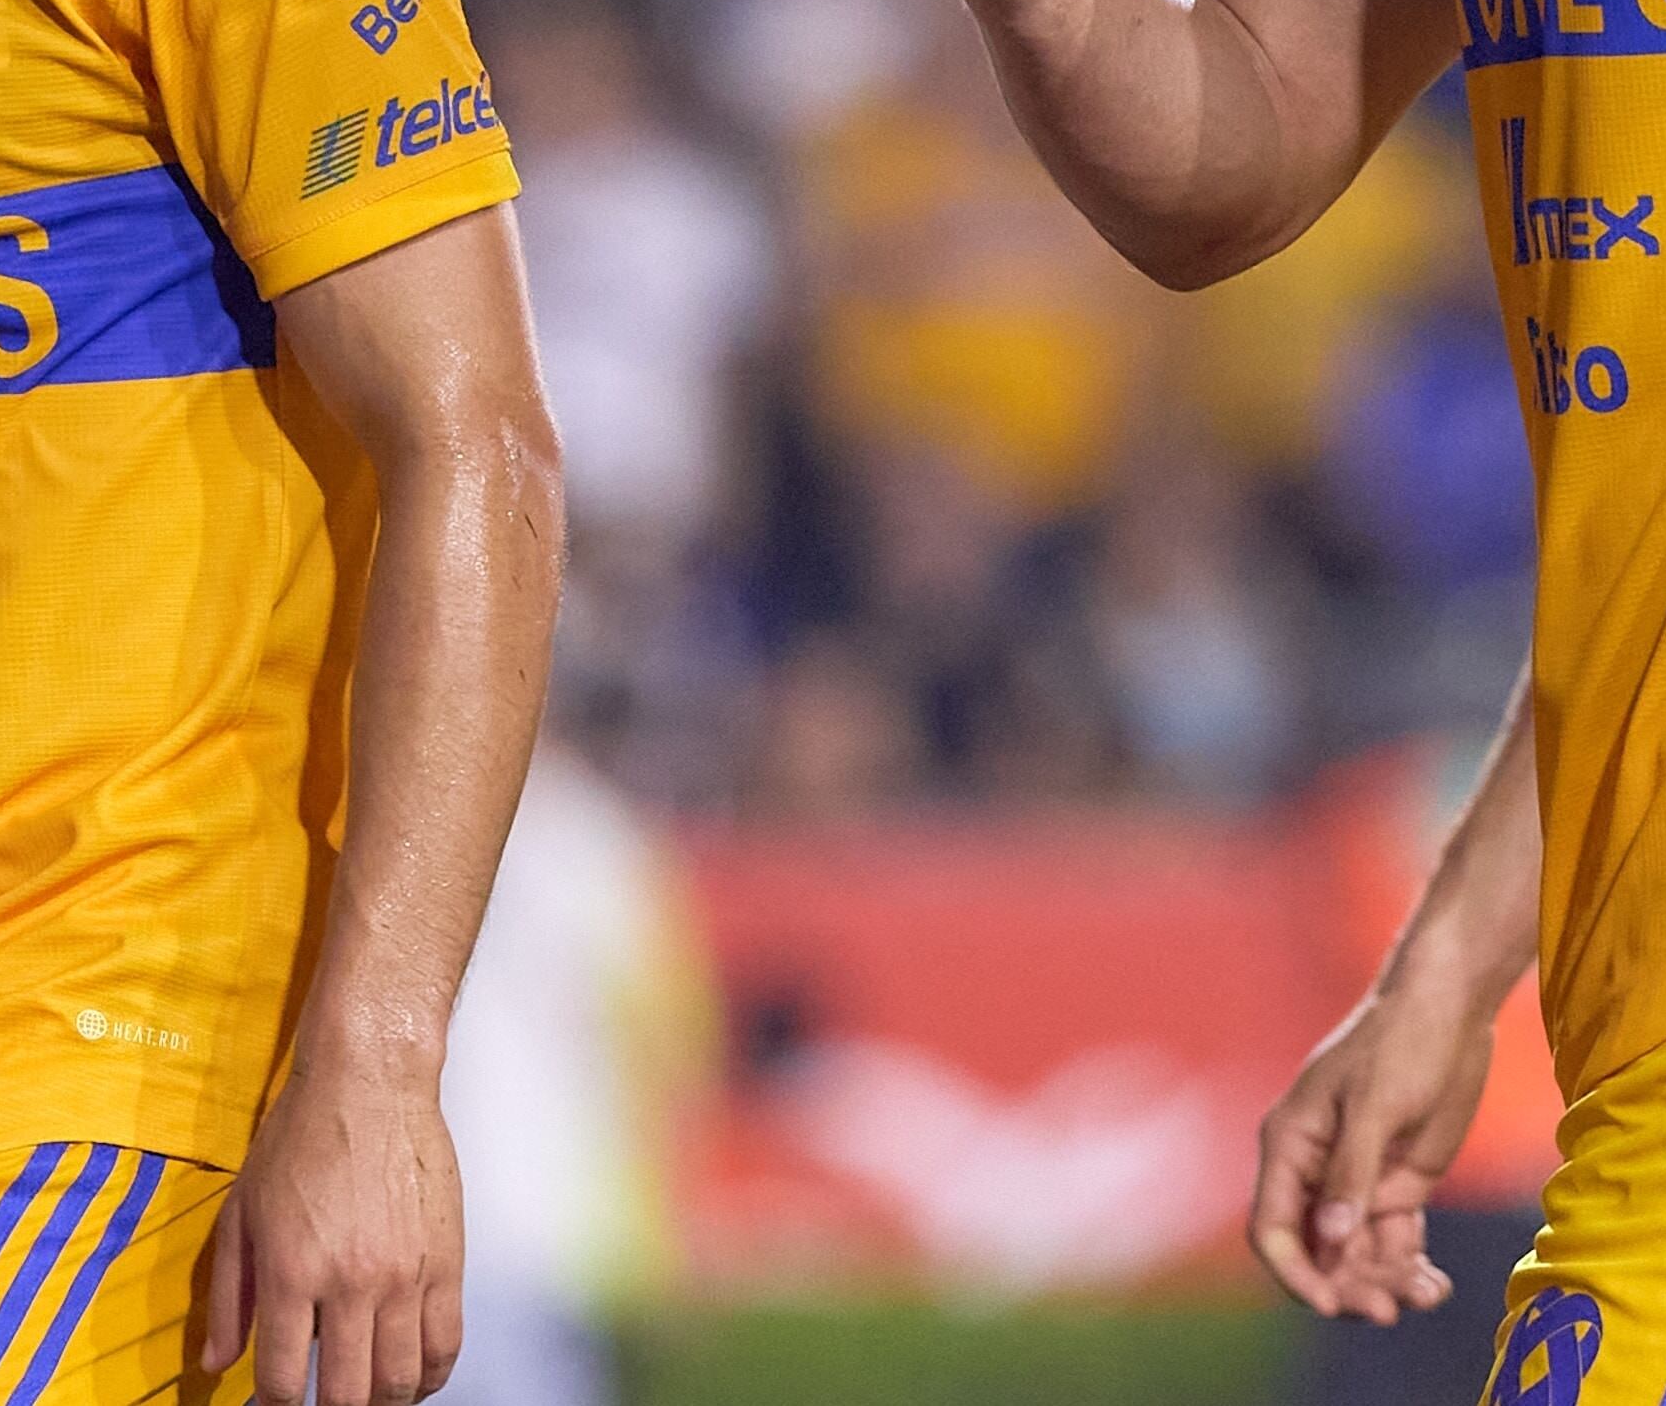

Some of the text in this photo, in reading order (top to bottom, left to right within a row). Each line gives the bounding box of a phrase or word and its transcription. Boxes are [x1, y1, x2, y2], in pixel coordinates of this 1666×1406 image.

[375, 70, 501, 168] telce
[1528, 195, 1660, 261] MEX
[113, 1021, 191, 1051] HEAT.RDY
